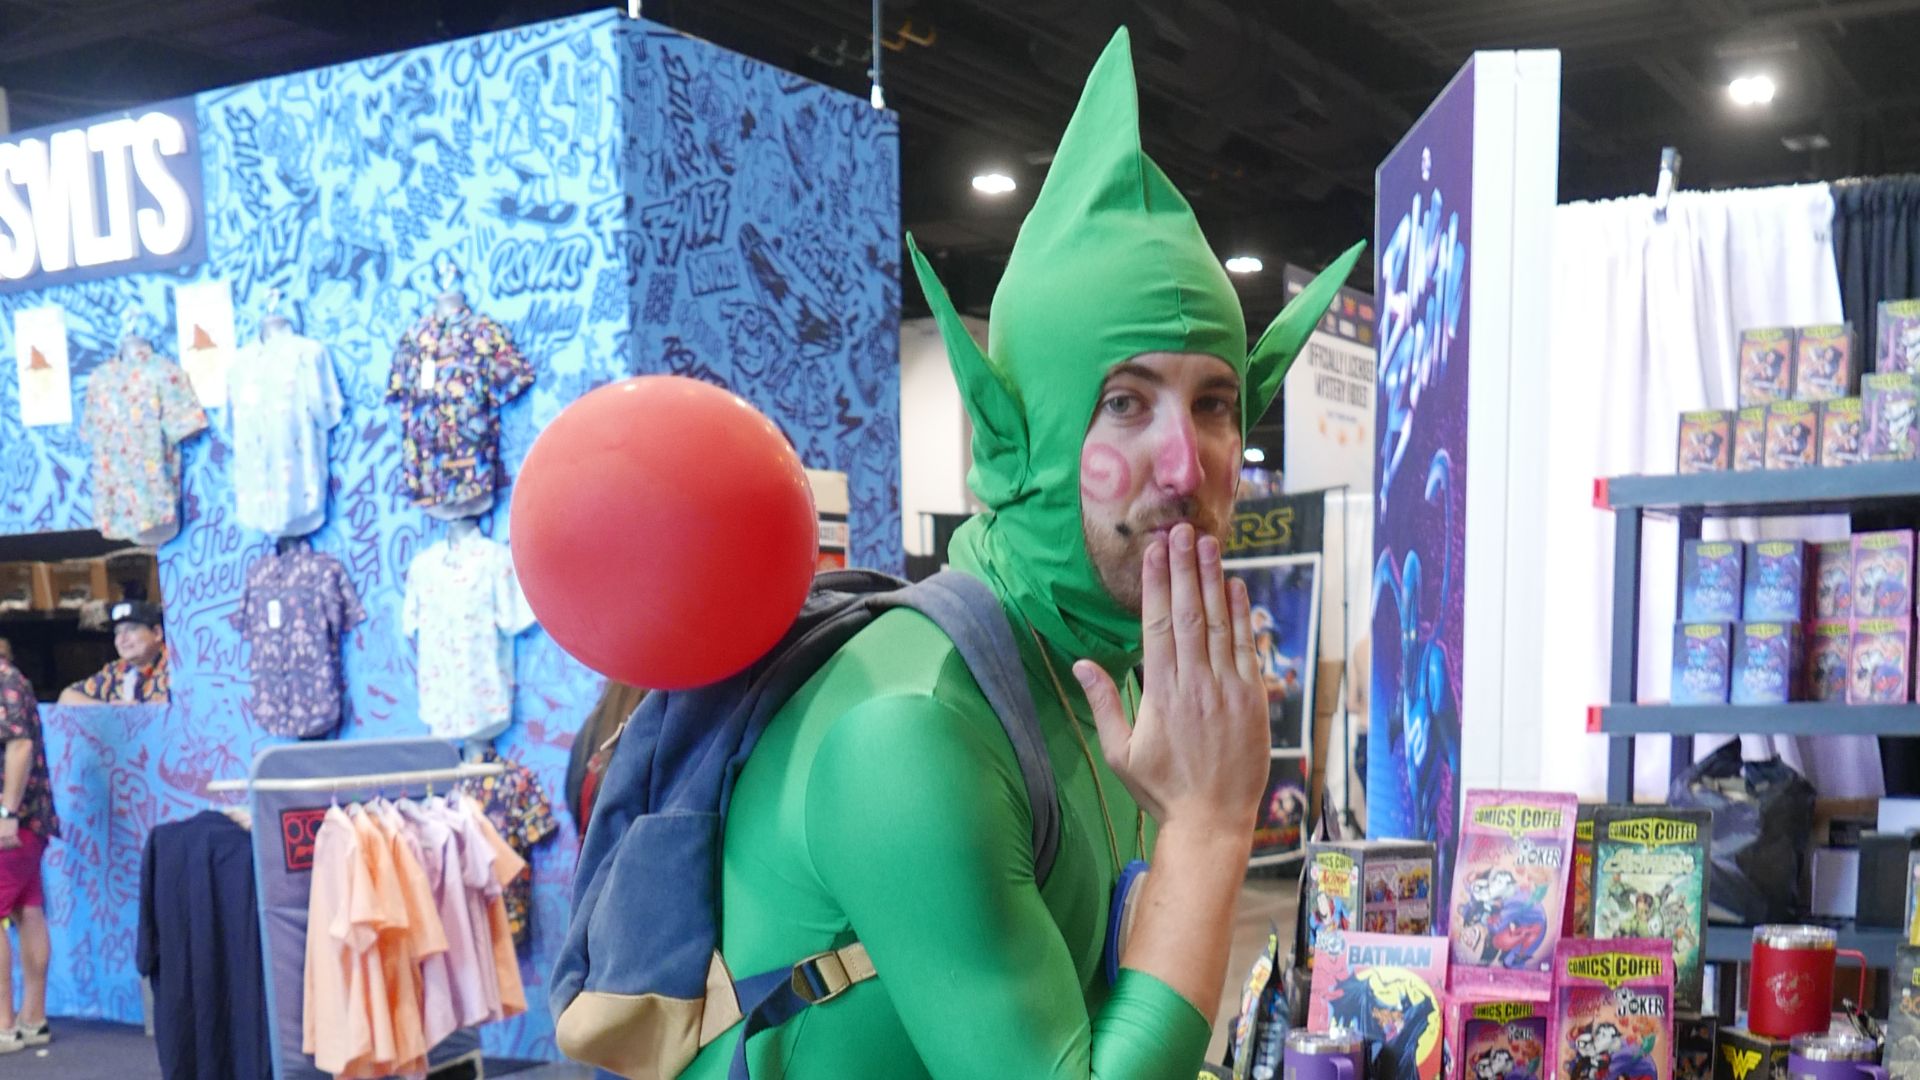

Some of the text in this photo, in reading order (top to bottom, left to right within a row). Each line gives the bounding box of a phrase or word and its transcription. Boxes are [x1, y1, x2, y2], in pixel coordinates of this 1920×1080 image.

[1474, 808, 1516, 828] COMICS
[1609, 822, 1696, 840] COMICS COFFEE
[1348, 945, 1431, 967] BATMAN
[1568, 956, 1661, 977] COMICS COFFEE
[1617, 996, 1665, 1017] JOKER
